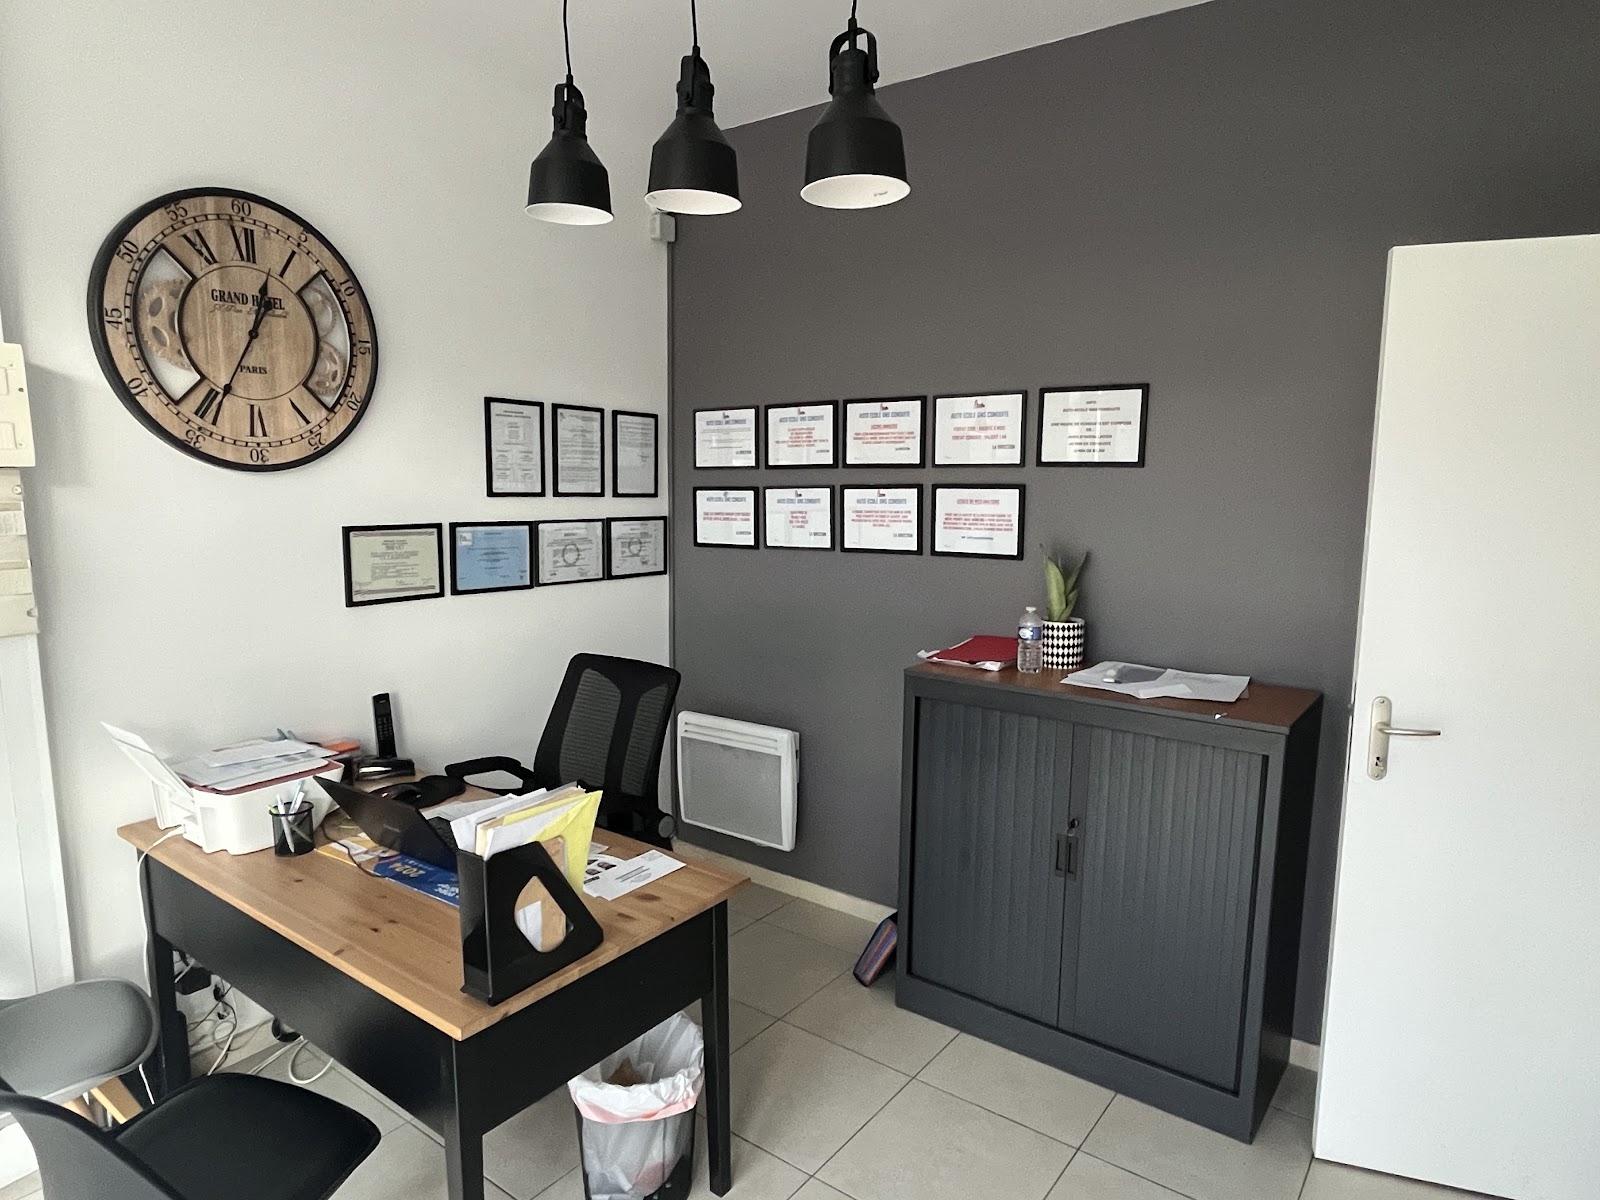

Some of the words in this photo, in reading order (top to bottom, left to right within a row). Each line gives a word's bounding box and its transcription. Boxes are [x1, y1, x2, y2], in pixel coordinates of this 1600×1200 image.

[165, 202, 188, 222] 55
[231, 199, 252, 217] 60
[117, 240, 139, 264] 50
[340, 278, 356, 297] 10
[211, 288, 249, 306] GRAND
[251, 294, 286, 311] HEL
[105, 307, 123, 330] 45
[358, 339, 371, 356] 15
[240, 365, 268, 375] PARIS
[127, 377, 149, 399] 40
[346, 391, 363, 411] 20
[185, 429, 206, 449] 35
[308, 433, 327, 451] 25
[250, 448, 270, 464] 30
[388, 862, 426, 878] 2024
